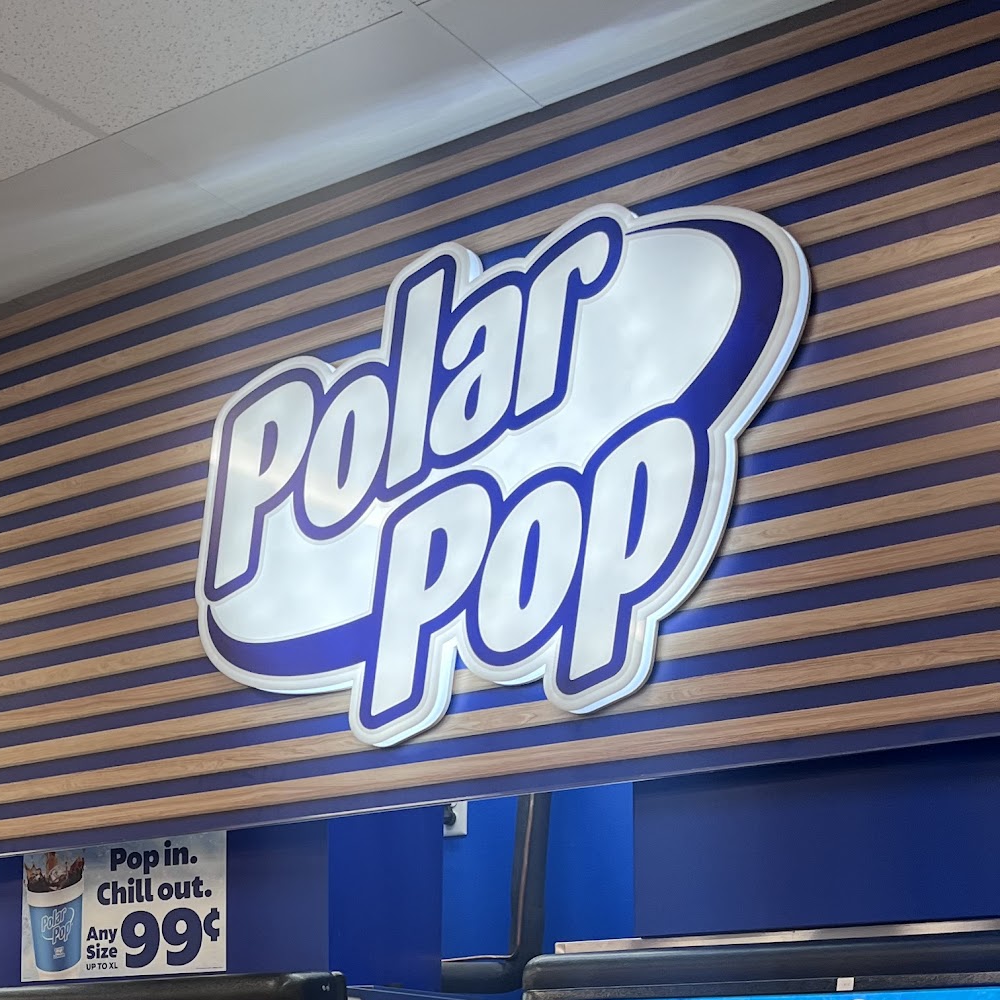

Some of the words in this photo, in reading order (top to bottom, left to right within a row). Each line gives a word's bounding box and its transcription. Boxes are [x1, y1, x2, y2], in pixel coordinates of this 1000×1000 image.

[208, 222, 618, 597] Polar
[364, 408, 704, 723] Pop
[110, 847, 160, 875] Pop
[163, 839, 198, 866] in.
[97, 877, 153, 905] Chill
[157, 875, 212, 901] out.
[41, 906, 66, 933] Polar
[52, 921, 73, 945] Pop
[86, 926, 118, 945] Any
[120, 907, 221, 969] 99¢
[86, 944, 118, 960] Size
[86, 963, 96, 971] UP
[97, 962, 108, 970] TO
[108, 962, 118, 970] XL
